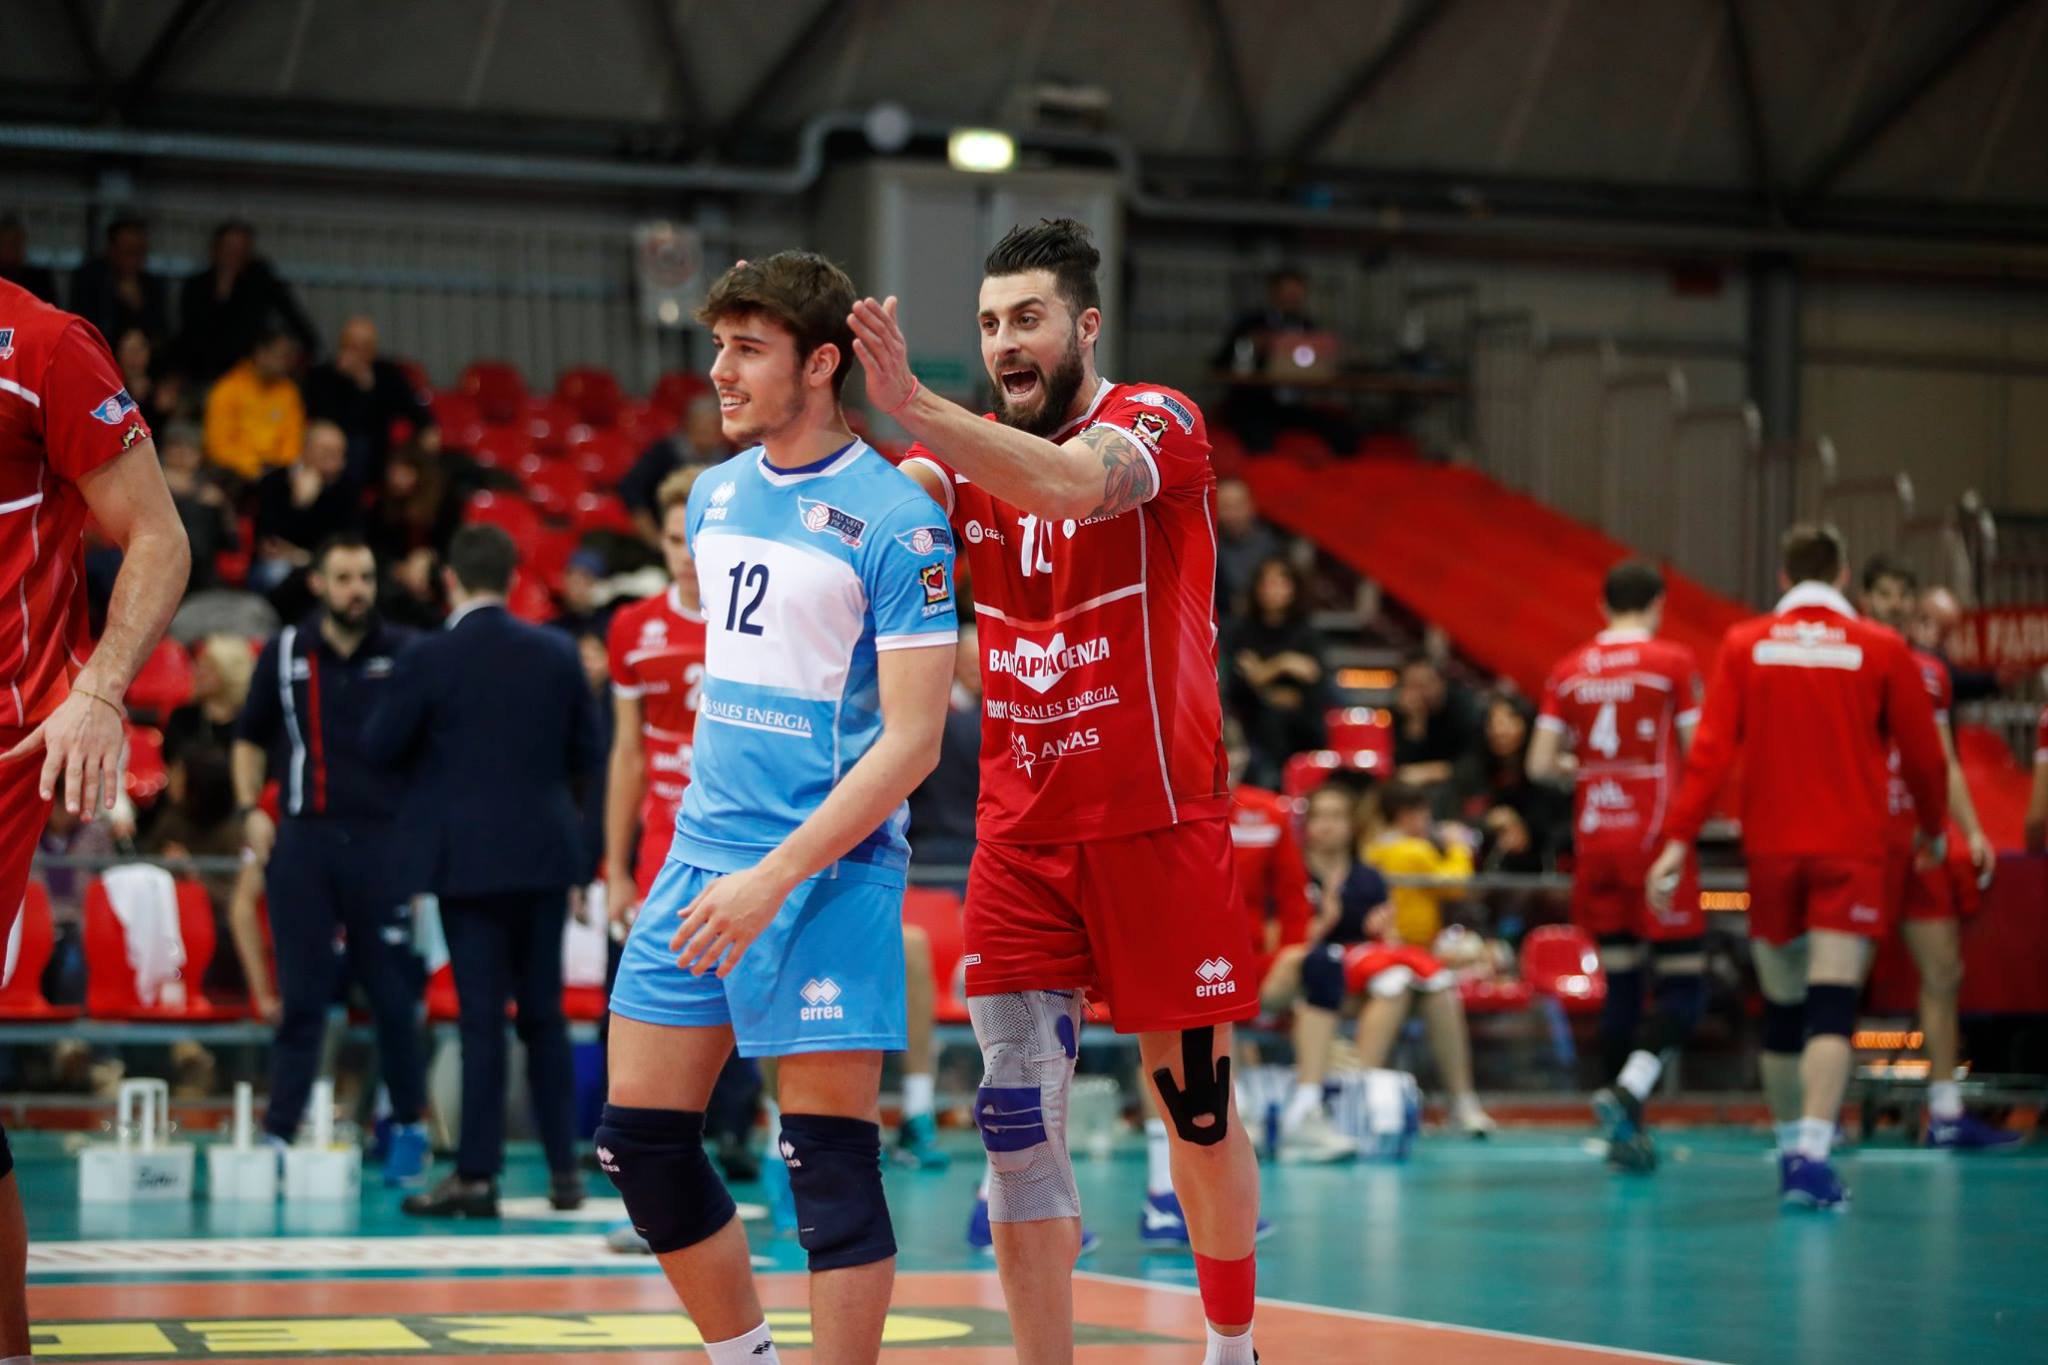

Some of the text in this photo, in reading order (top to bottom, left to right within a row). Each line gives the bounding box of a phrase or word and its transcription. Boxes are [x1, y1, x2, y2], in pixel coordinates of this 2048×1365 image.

[725, 560, 770, 636] 12
[1024, 701, 1063, 718] SALES
[747, 708, 812, 732] ENERGIA
[1196, 980, 1236, 997] errea
[800, 1004, 843, 1021] errea
